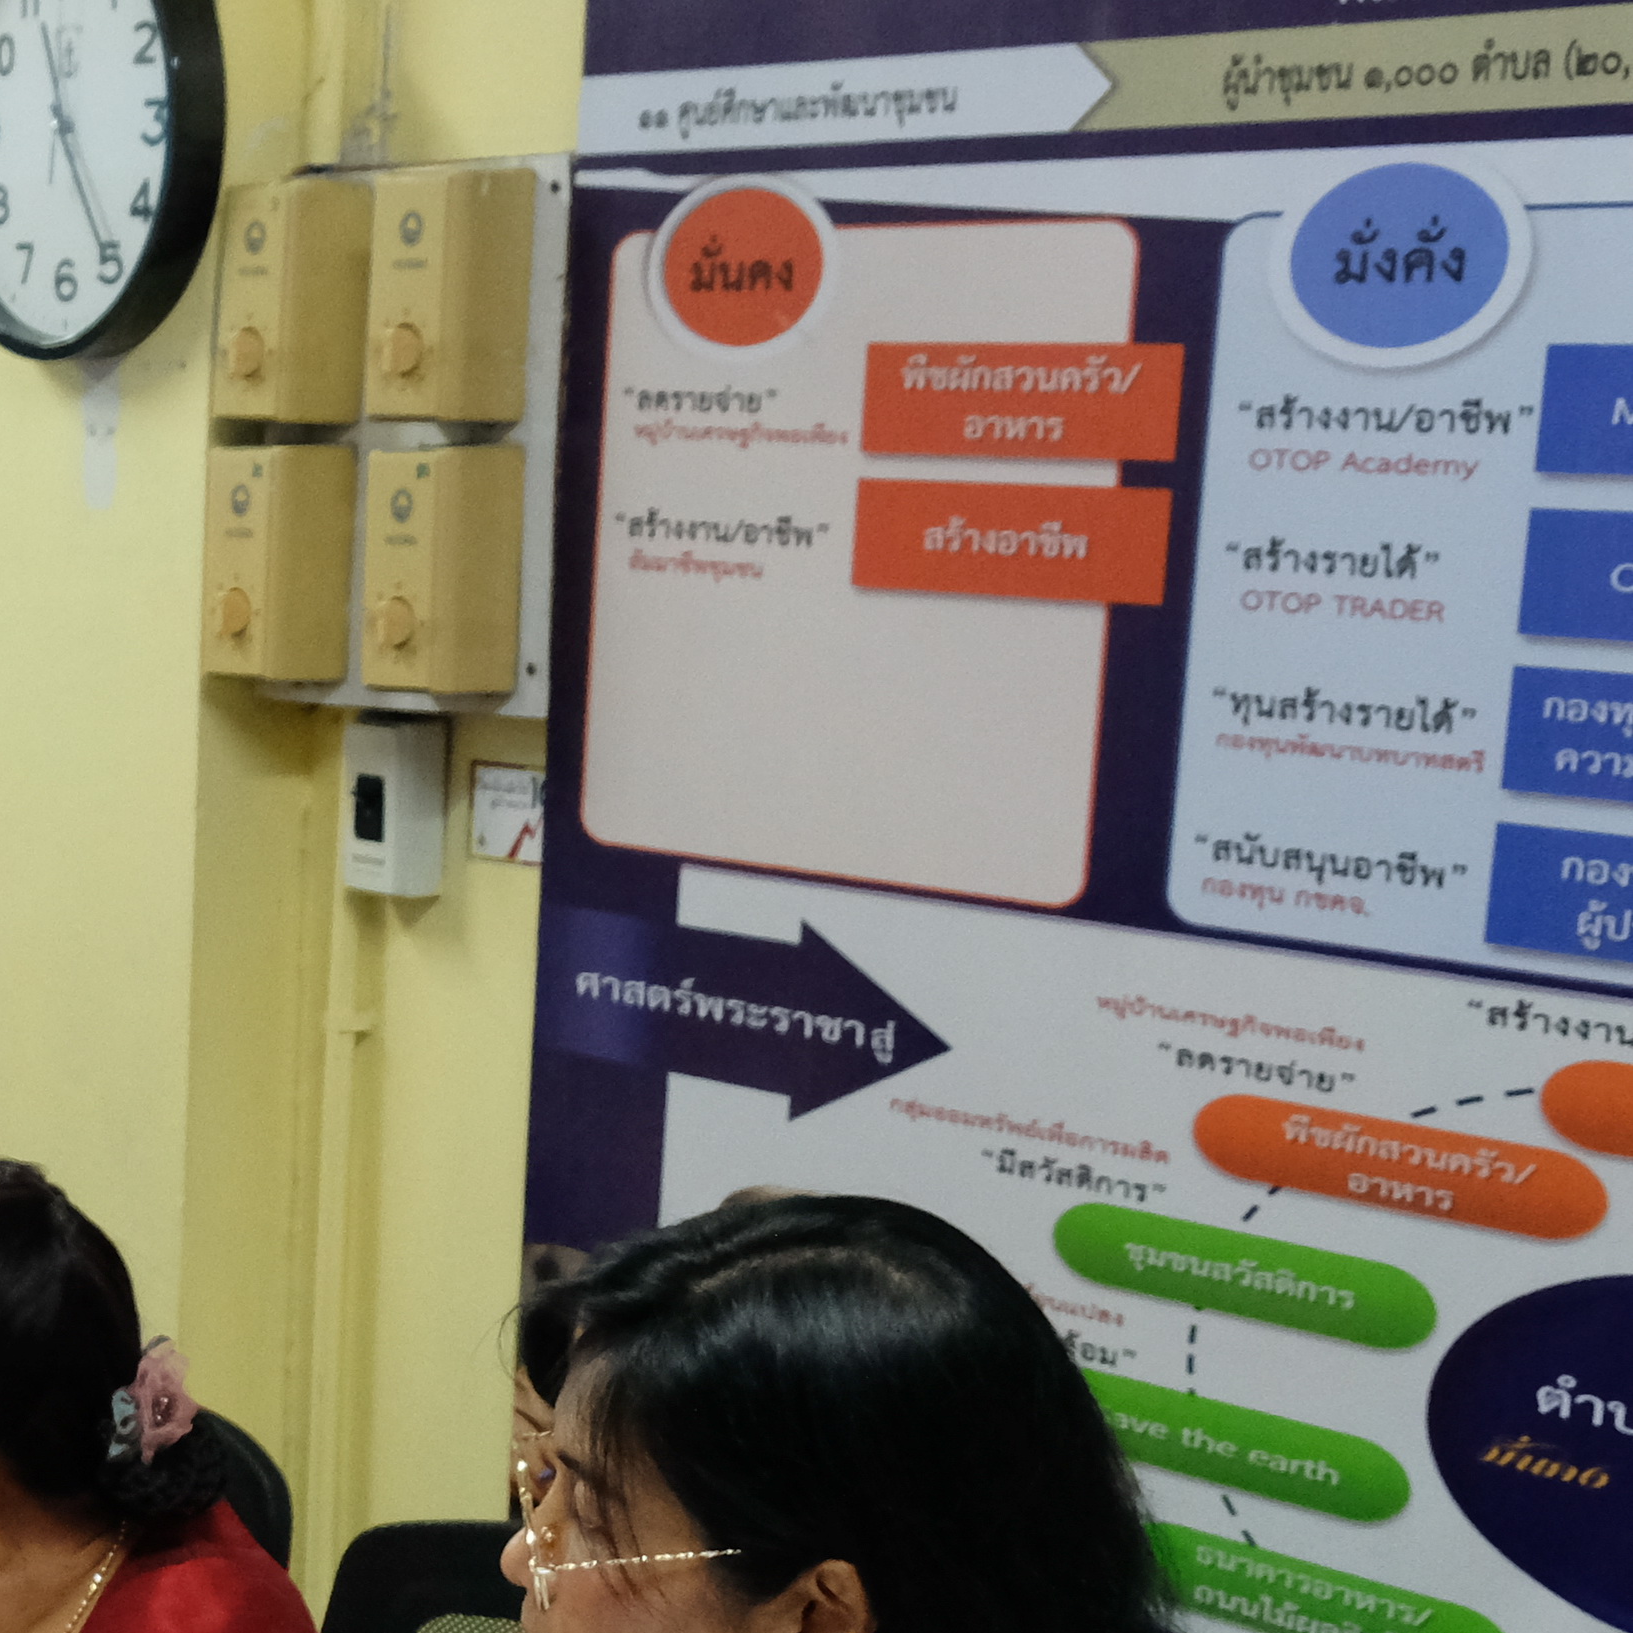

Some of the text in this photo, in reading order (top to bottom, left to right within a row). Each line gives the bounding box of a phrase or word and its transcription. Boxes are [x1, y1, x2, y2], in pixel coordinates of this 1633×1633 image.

[132, 20, 158, 65] 2
[1223, 51, 1354, 111] ผู้นำชุมชน
[1363, 62, 1459, 93] ๑,๐๐๐
[1472, 38, 1551, 82] ตำบล
[141, 98, 168, 147] 3
[677, 79, 958, 139] ศูนย์ศึกษาและพัฒนาชุมชน
[130, 178, 153, 223] 4
[15, 242, 33, 285] 7
[97, 241, 125, 285] 5
[690, 234, 794, 292] มั่นคง
[1334, 214, 1467, 285] มั่งคั่ง
[54, 258, 78, 302] 6
[900, 353, 1143, 396] พืชผักสวนครัว/
[963, 412, 1064, 441] อาหาร
[1248, 447, 1481, 481] OTOP Academy
[922, 515, 1090, 560] สร้างอาชีพ
[1239, 589, 1446, 623] OTOP TRADER
[1215, 732, 1486, 774] กองทุนพัฒนาบทบาทสตรี
[1201, 875, 1285, 910] กองทุน
[575, 970, 896, 1065] ศาสตร์พระราชา สู่
[1096, 992, 1367, 1054] หมู่บ้านเศรษฐกิจพอเพียง
[1281, 1113, 1537, 1186] พืชผักสวนครัว/
[1346, 1170, 1454, 1214] อาหาร
[1124, 1238, 1355, 1312] ชุมชนสวัสดิการ
[1103, 1411, 1340, 1486] ave the earth
[1196, 1545, 1433, 1627] ธนาคารอาหาร/
